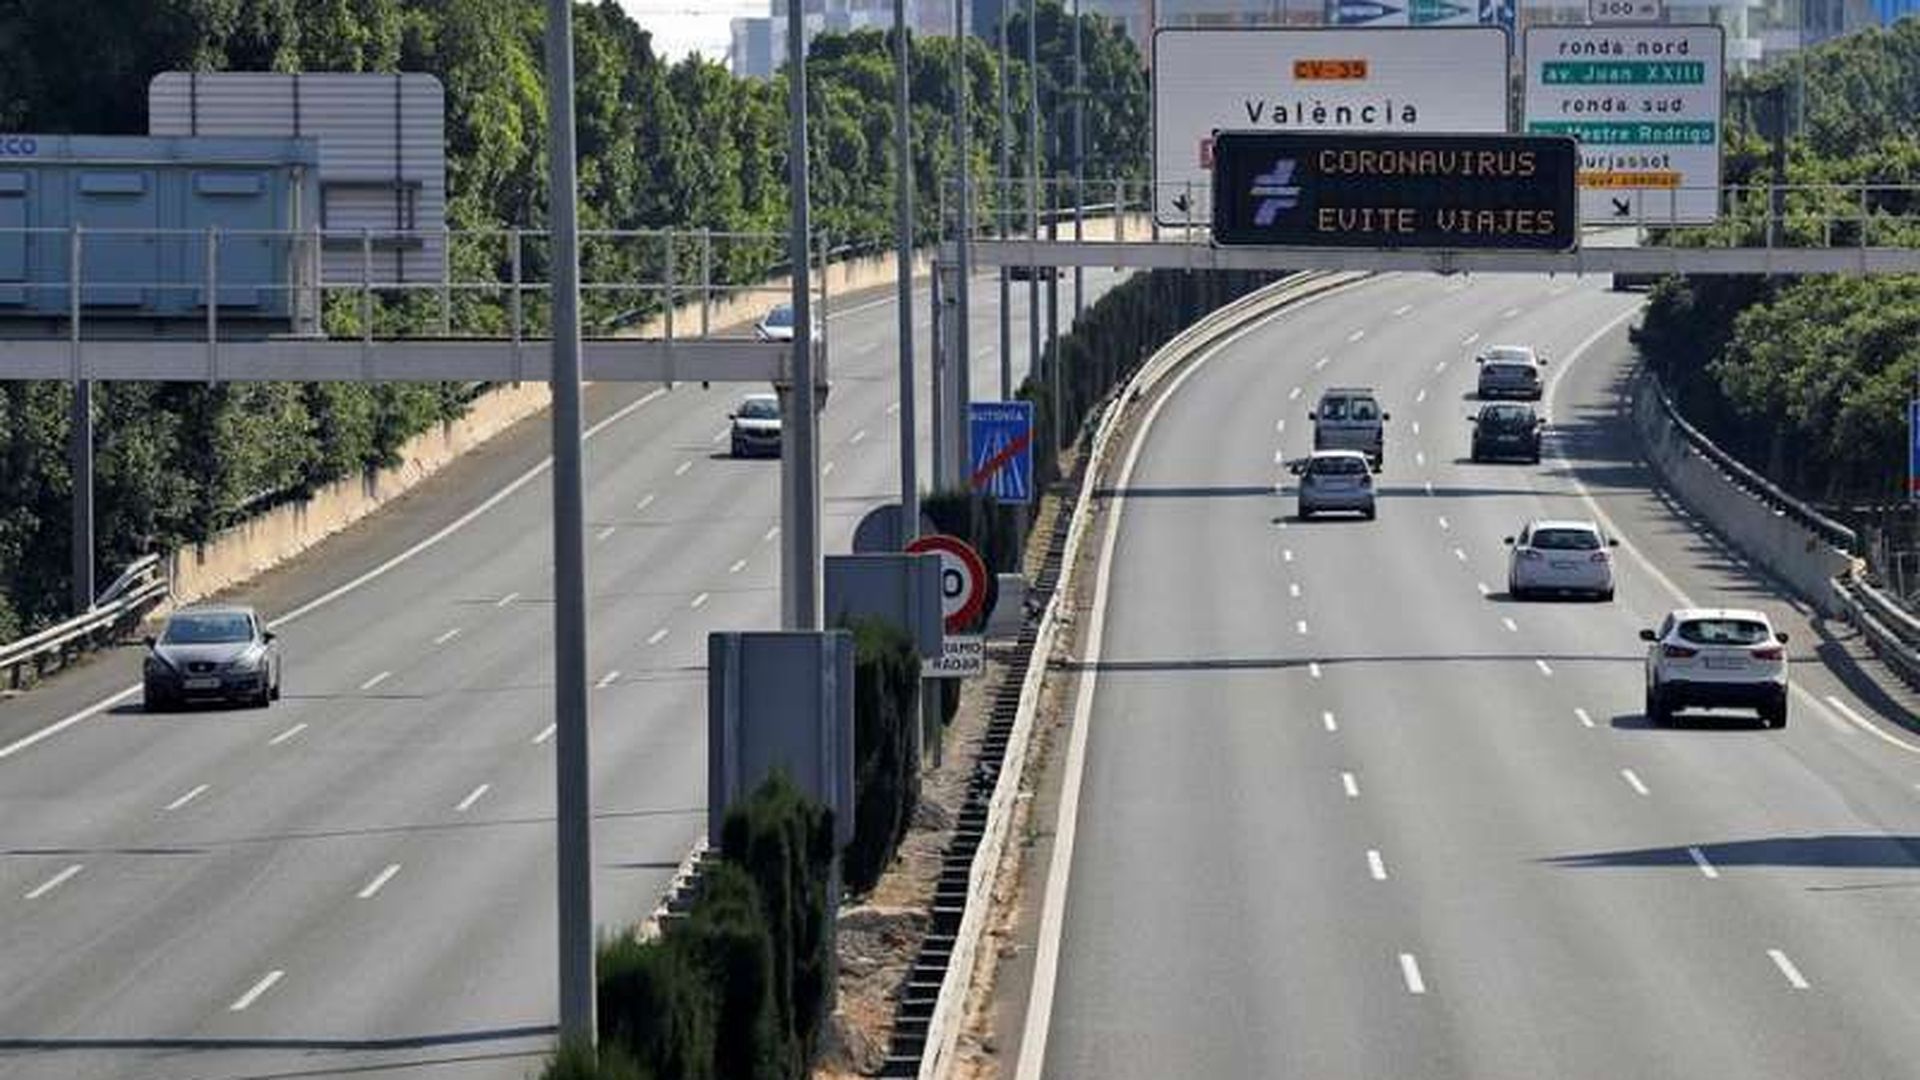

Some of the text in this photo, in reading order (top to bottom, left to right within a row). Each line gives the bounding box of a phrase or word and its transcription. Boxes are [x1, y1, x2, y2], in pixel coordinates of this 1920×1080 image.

[1559, 39, 1689, 55] ronda nord
[1584, 64, 1632, 81] Juan
[1246, 101, 1418, 124] València
[1562, 99, 1683, 114] ronda sud
[1318, 150, 1537, 176] CORONAVIRUS
[1318, 207, 1556, 234] EVITE VIAJES
[943, 569, 963, 598] 0
